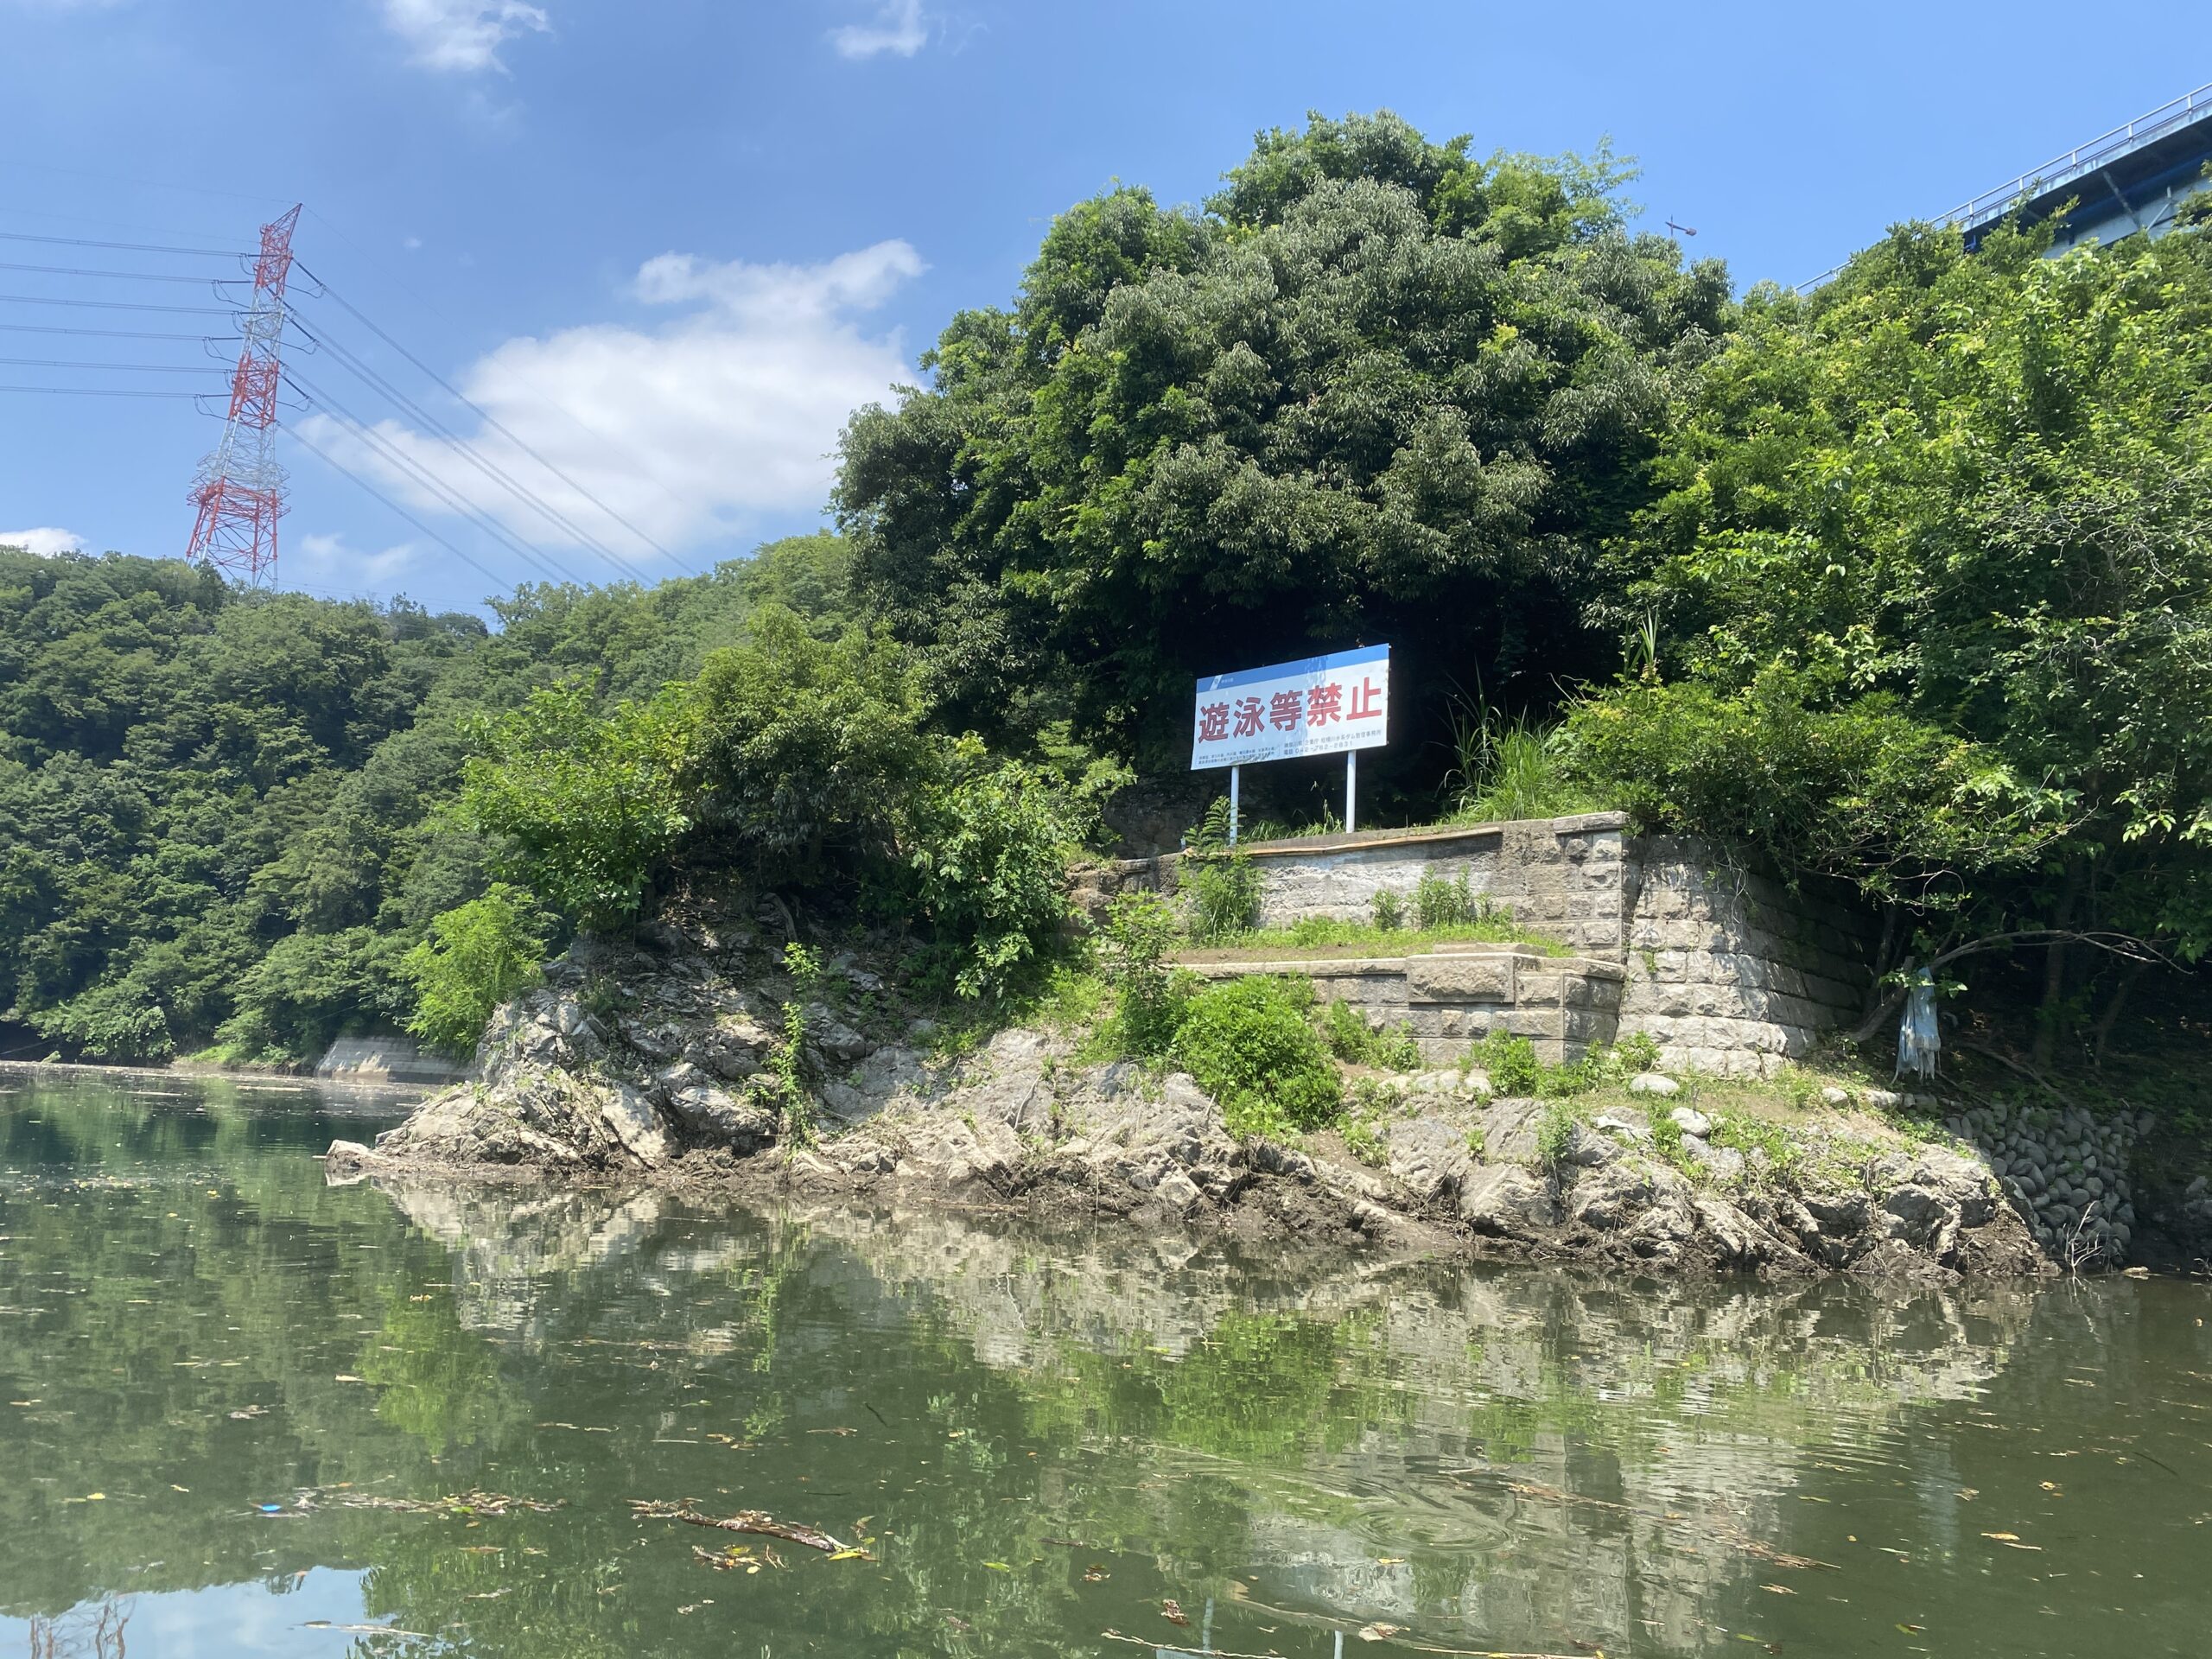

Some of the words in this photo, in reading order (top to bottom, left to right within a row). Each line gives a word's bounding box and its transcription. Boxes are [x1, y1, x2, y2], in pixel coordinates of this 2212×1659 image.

[1198, 677, 1382, 744] 遊泳等禁止
